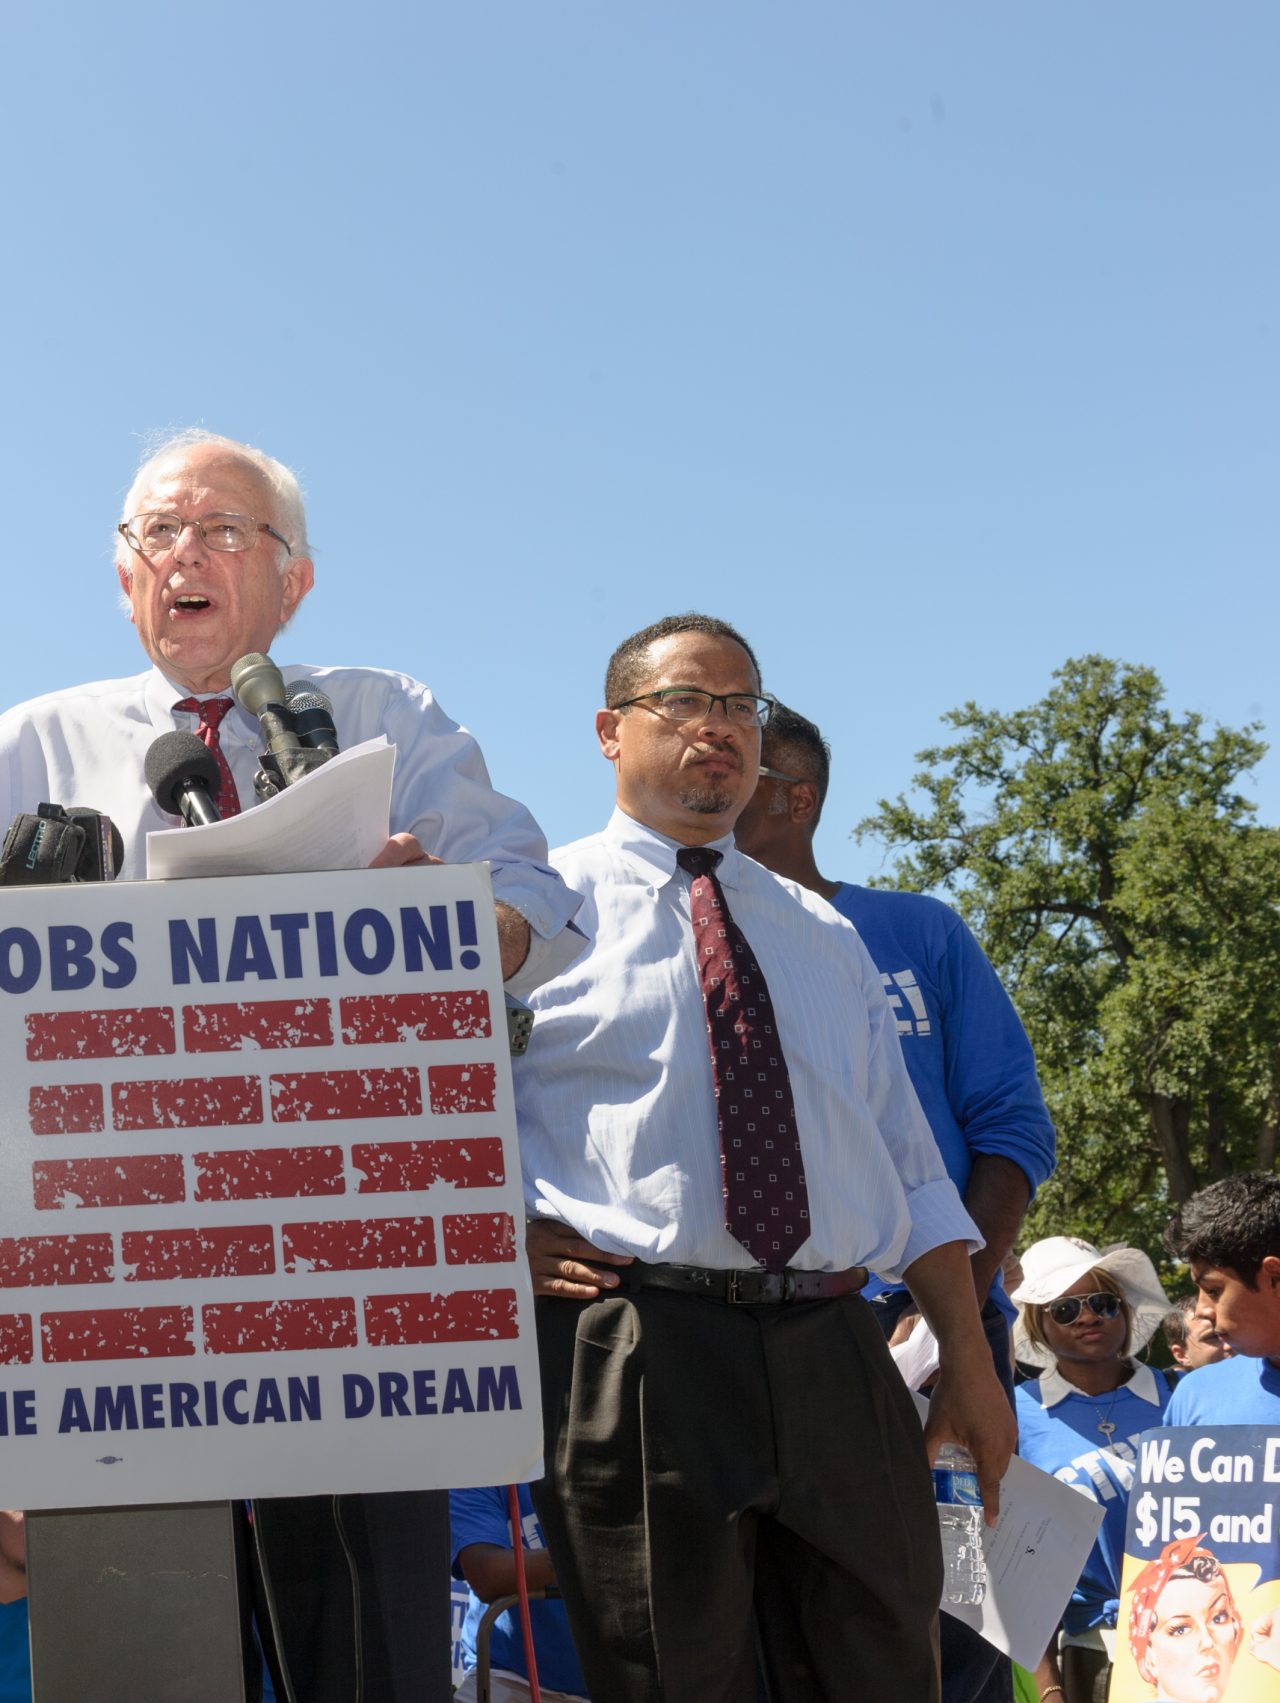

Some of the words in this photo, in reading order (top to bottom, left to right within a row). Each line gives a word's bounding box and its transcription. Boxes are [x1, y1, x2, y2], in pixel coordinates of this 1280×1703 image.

[168, 900, 482, 985] NATION!
[58, 1375, 322, 1434] AMERICAN
[342, 1365, 523, 1419] DREAM
[1140, 1439, 1186, 1484] We
[1189, 1437, 1254, 1483] Can
[1135, 1491, 1201, 1547] $15
[1210, 1503, 1273, 1544] and
